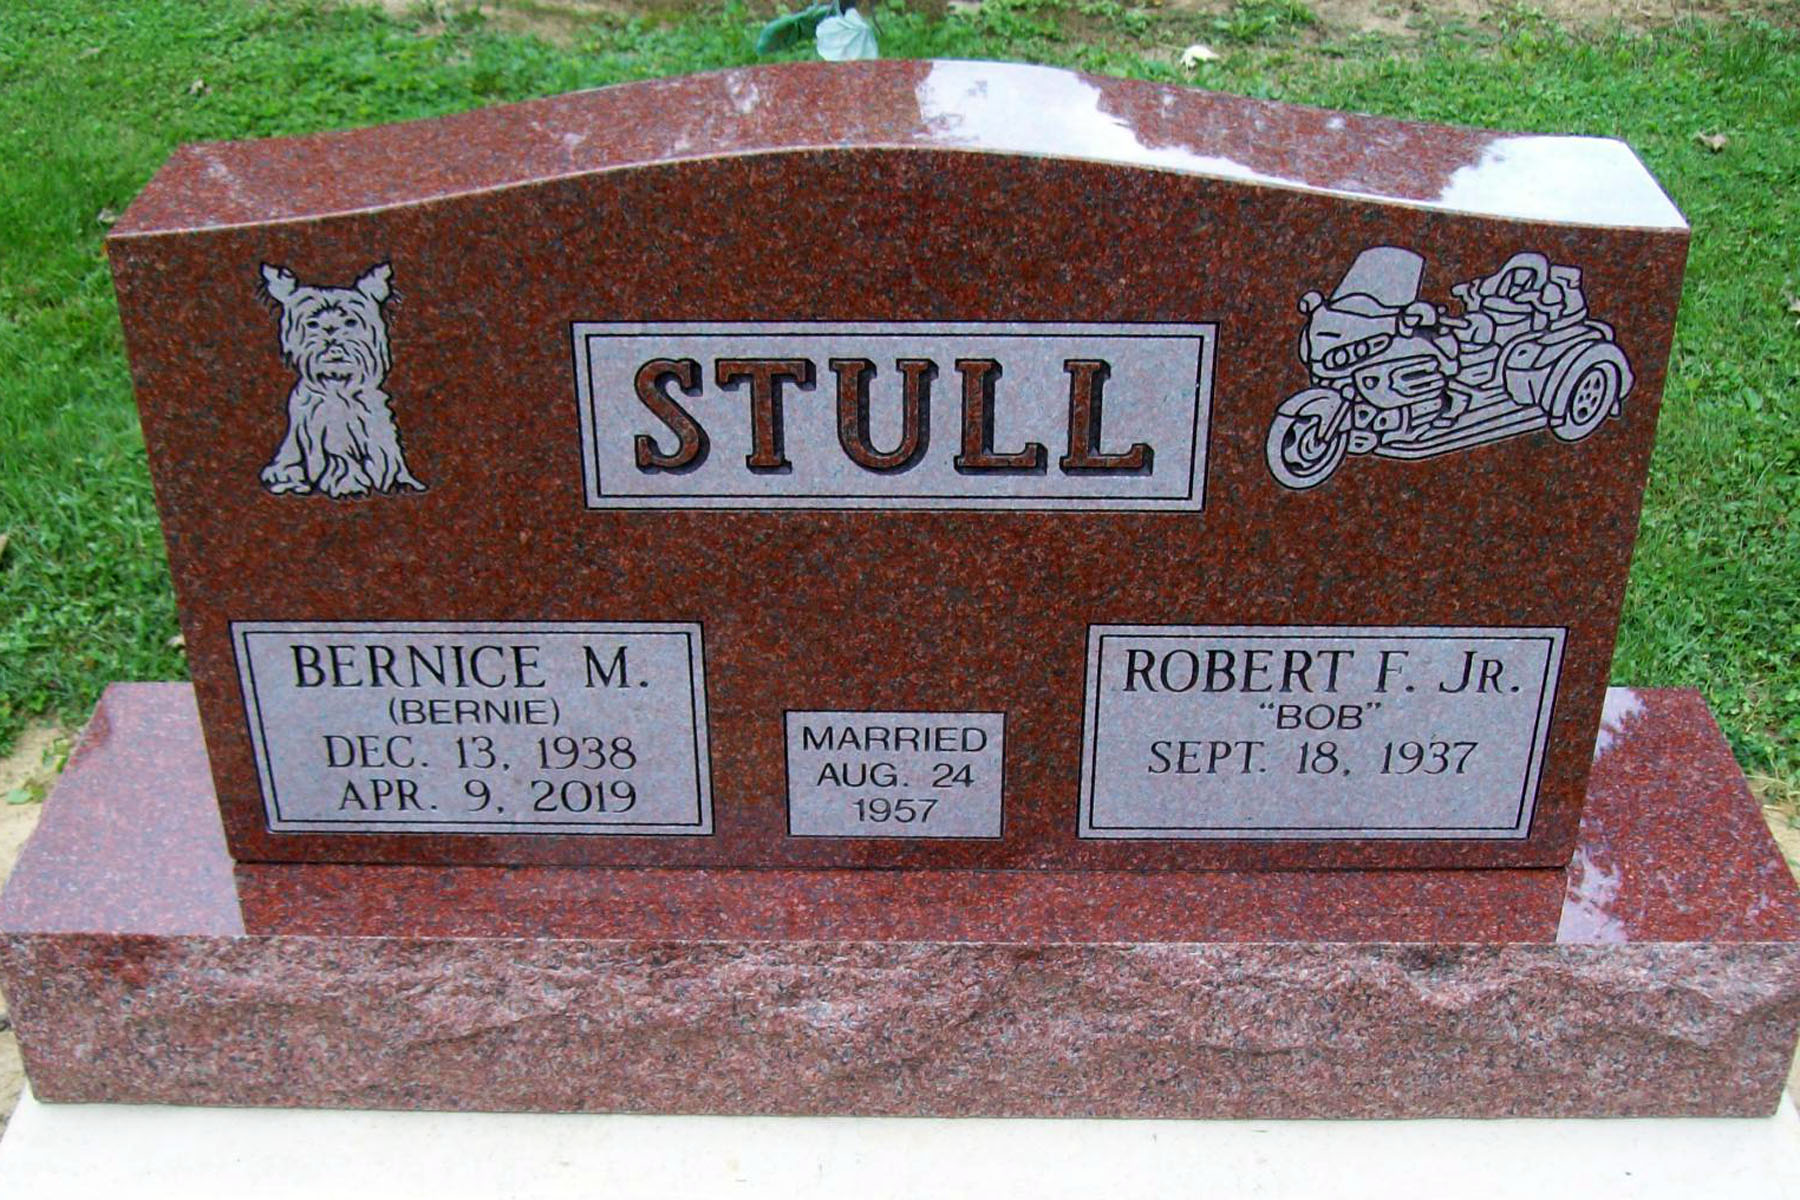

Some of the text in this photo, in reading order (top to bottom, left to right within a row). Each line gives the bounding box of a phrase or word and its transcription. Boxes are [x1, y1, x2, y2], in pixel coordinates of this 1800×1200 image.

[634, 357, 1155, 475] STULL
[290, 645, 650, 688] BERNICE M.
[1121, 648, 1355, 693] ROBERT
[1376, 650, 1415, 694] F.
[388, 697, 560, 726] (BERNIE)
[323, 735, 637, 772] DEC. 13, 1938
[802, 726, 988, 752] MARRIED
[817, 762, 974, 788] AUG. 24
[1148, 740, 1479, 777] SEPT. 18, 1937
[338, 779, 637, 814] APR. 9, 2019
[853, 798, 939, 823] 1957
